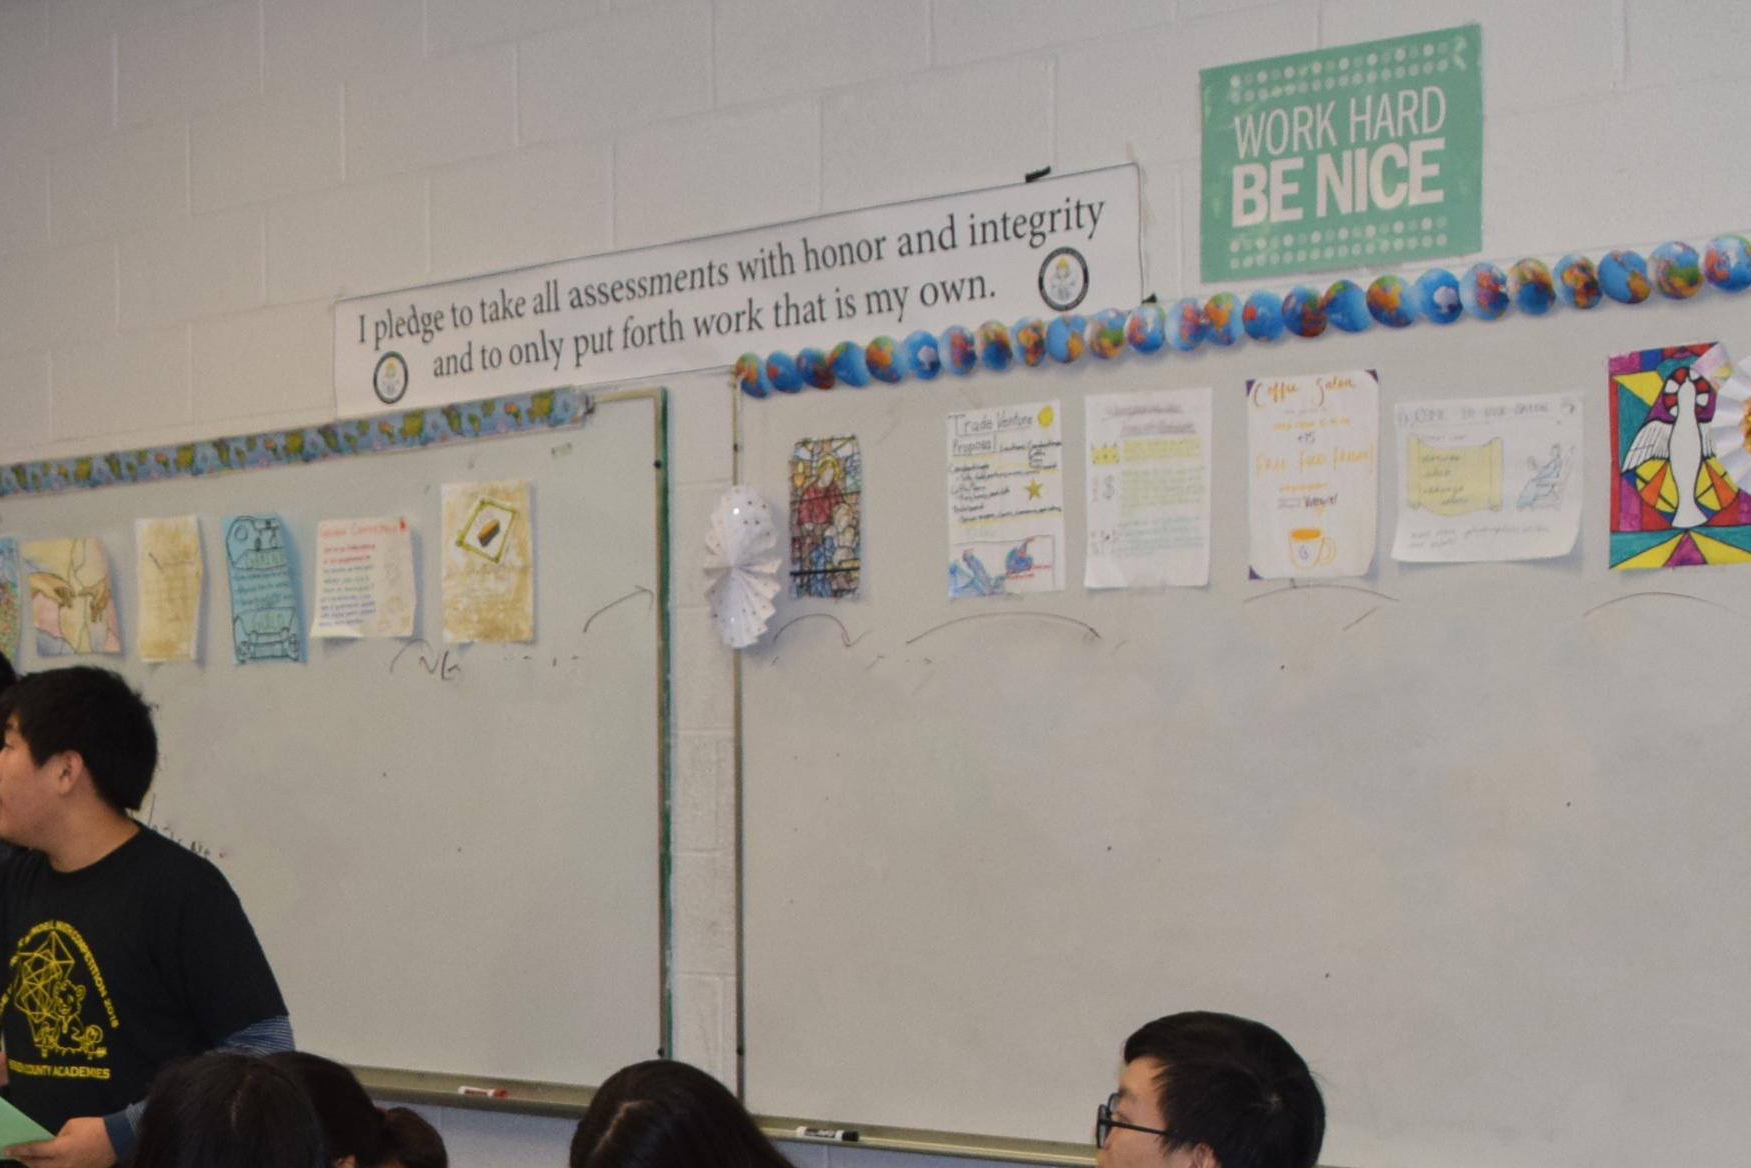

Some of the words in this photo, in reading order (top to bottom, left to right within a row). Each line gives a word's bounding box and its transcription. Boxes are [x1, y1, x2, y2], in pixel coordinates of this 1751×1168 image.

[1234, 100, 1338, 160] WORK
[1350, 85, 1447, 144] HARD
[1232, 156, 1304, 228] BE
[1316, 137, 1446, 218] NICE
[358, 314, 367, 344] I
[373, 303, 445, 351] pledge
[451, 300, 474, 328] to
[480, 289, 527, 325] take
[533, 278, 561, 316] all
[568, 261, 730, 309] assessments
[737, 241, 796, 283] with
[801, 235, 888, 273] honor
[897, 213, 957, 258] and
[968, 197, 1107, 250] integrity
[433, 341, 474, 378] and
[480, 343, 503, 370] to
[509, 329, 566, 371] only
[574, 326, 615, 369] put
[621, 309, 685, 351] forth
[693, 297, 764, 338] work
[772, 290, 832, 330] that
[835, 286, 858, 319] is
[866, 283, 911, 324] my
[919, 272, 997, 308] own.
[948, 414, 993, 436] Trade
[952, 433, 997, 456] Proposal
[53, 1065, 112, 1080] ACADEMIES
